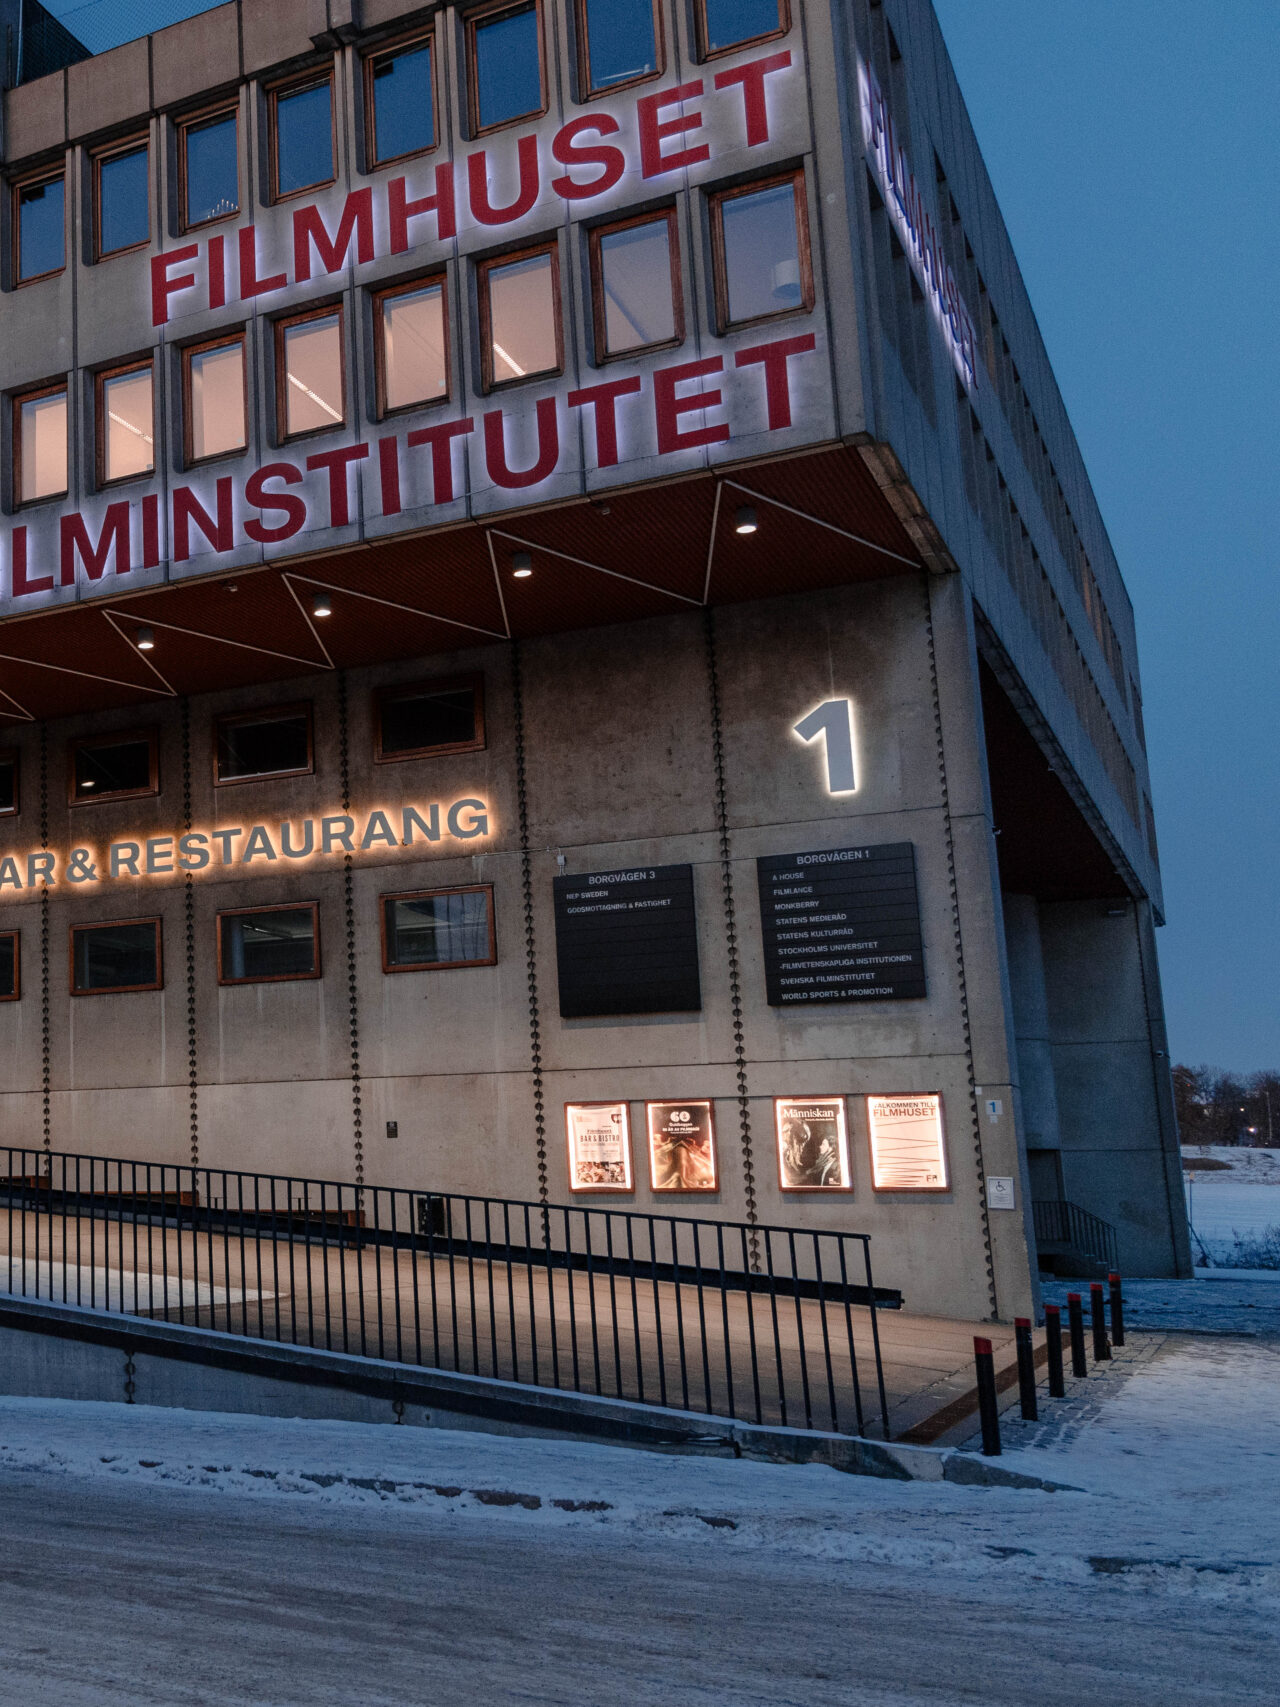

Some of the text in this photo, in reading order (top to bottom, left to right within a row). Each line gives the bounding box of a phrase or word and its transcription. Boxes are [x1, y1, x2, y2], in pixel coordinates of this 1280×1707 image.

[150, 50, 792, 327] FILMHUSET
[792, 698, 857, 794] 1
[65, 847, 98, 884] &
[110, 797, 490, 878] RESTAURANG
[796, 850, 870, 865] BORGVÄGEN 1
[588, 871, 656, 885] BORGVÄGEN 3
[779, 872, 805, 881] HOUSE
[581, 891, 609, 899] SWEDEN
[773, 886, 813, 896] FILMLANCE
[567, 903, 628, 914] GODSMOTTAGNING
[635, 899, 672, 909] FASTIGHET
[775, 901, 820, 911] MONKBERRY
[776, 912, 847, 926] STATENS MEDIERÅD
[777, 927, 854, 940] STATENS KULTURRÅD
[778, 941, 879, 955] STOCKHOLMS UNIVERSITET
[856, 954, 912, 965] INSTITUTIONEN
[781, 972, 876, 985] SVENSKA FILMINSTITUTET
[782, 992, 808, 1000] WORLD
[810, 989, 839, 999] SPORTS
[848, 987, 893, 997] PROMOTION
[783, 1108, 834, 1118] Människan
[873, 1107, 937, 1117] FILMHUSET
[989, 1101, 996, 1113] 1
[580, 1135, 592, 1143] BAR
[598, 1134, 620, 1142] BISTRO
